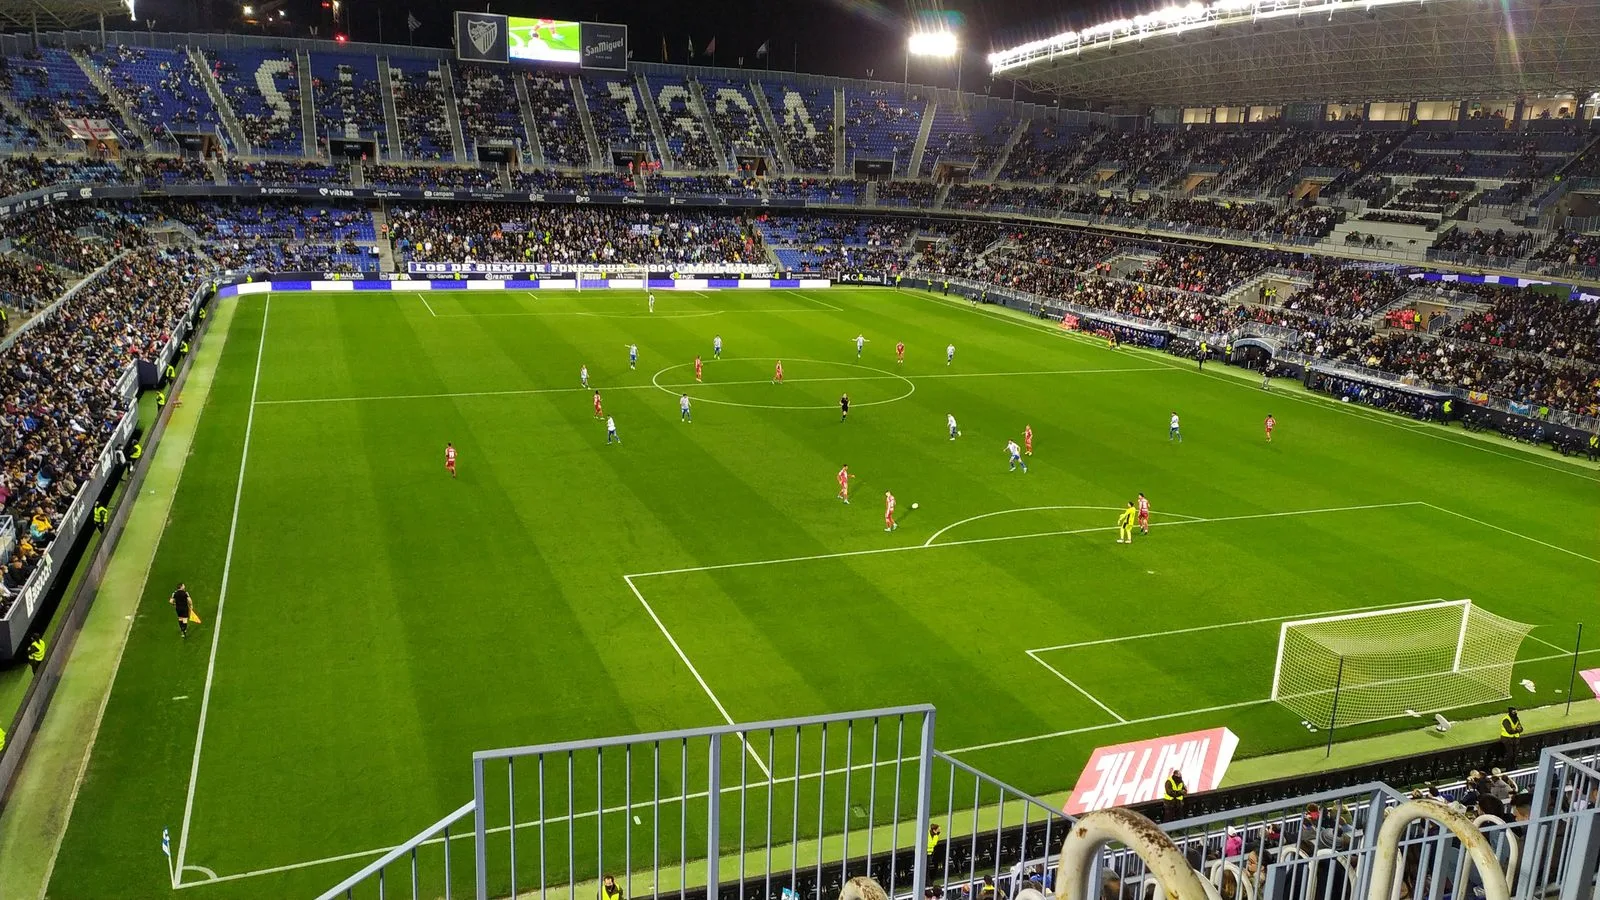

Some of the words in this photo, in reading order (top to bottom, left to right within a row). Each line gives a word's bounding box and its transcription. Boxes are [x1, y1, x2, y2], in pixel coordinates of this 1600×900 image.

[329, 188, 354, 197] vithas
[416, 263, 446, 272] LOS
[451, 263, 472, 272] DE
[476, 263, 546, 273] SIEMPRE
[551, 263, 595, 273] FONDO
